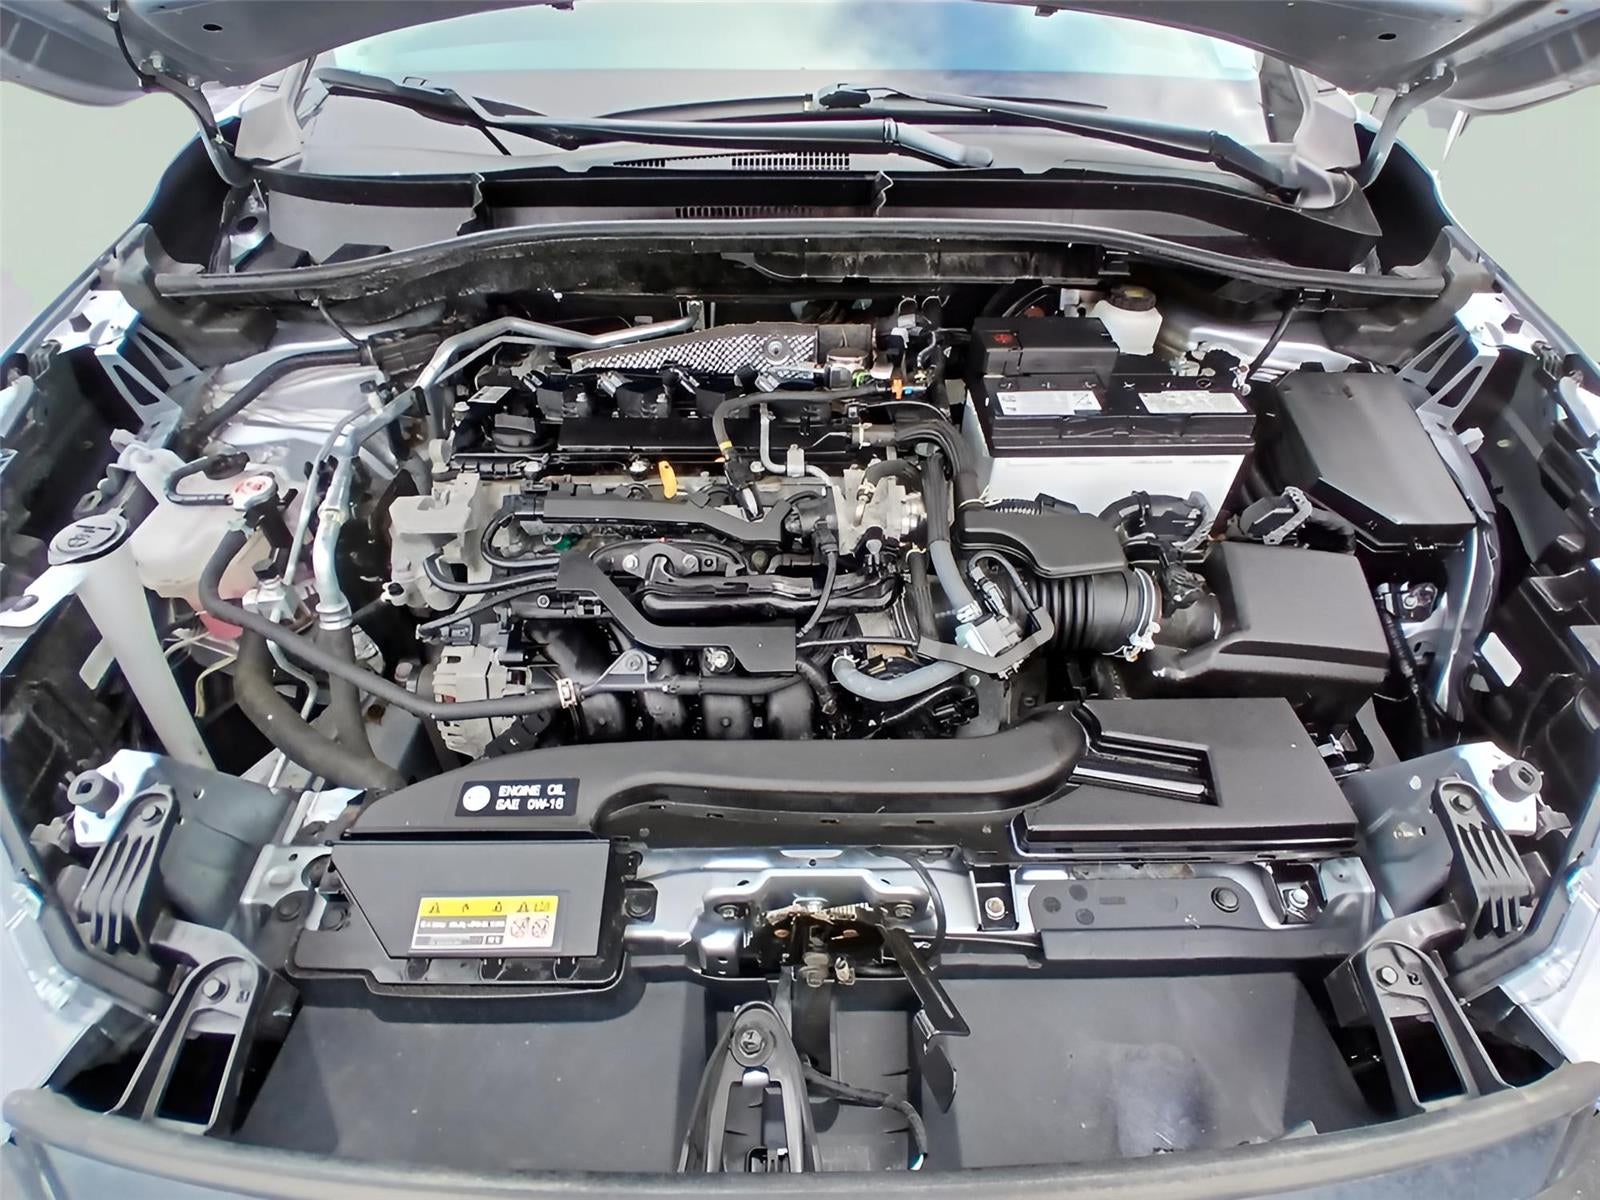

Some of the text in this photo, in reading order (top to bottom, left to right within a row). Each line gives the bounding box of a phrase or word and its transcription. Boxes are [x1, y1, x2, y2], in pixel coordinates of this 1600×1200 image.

[498, 784, 566, 797] ENGINE OIL
[495, 799, 520, 810] SAE
